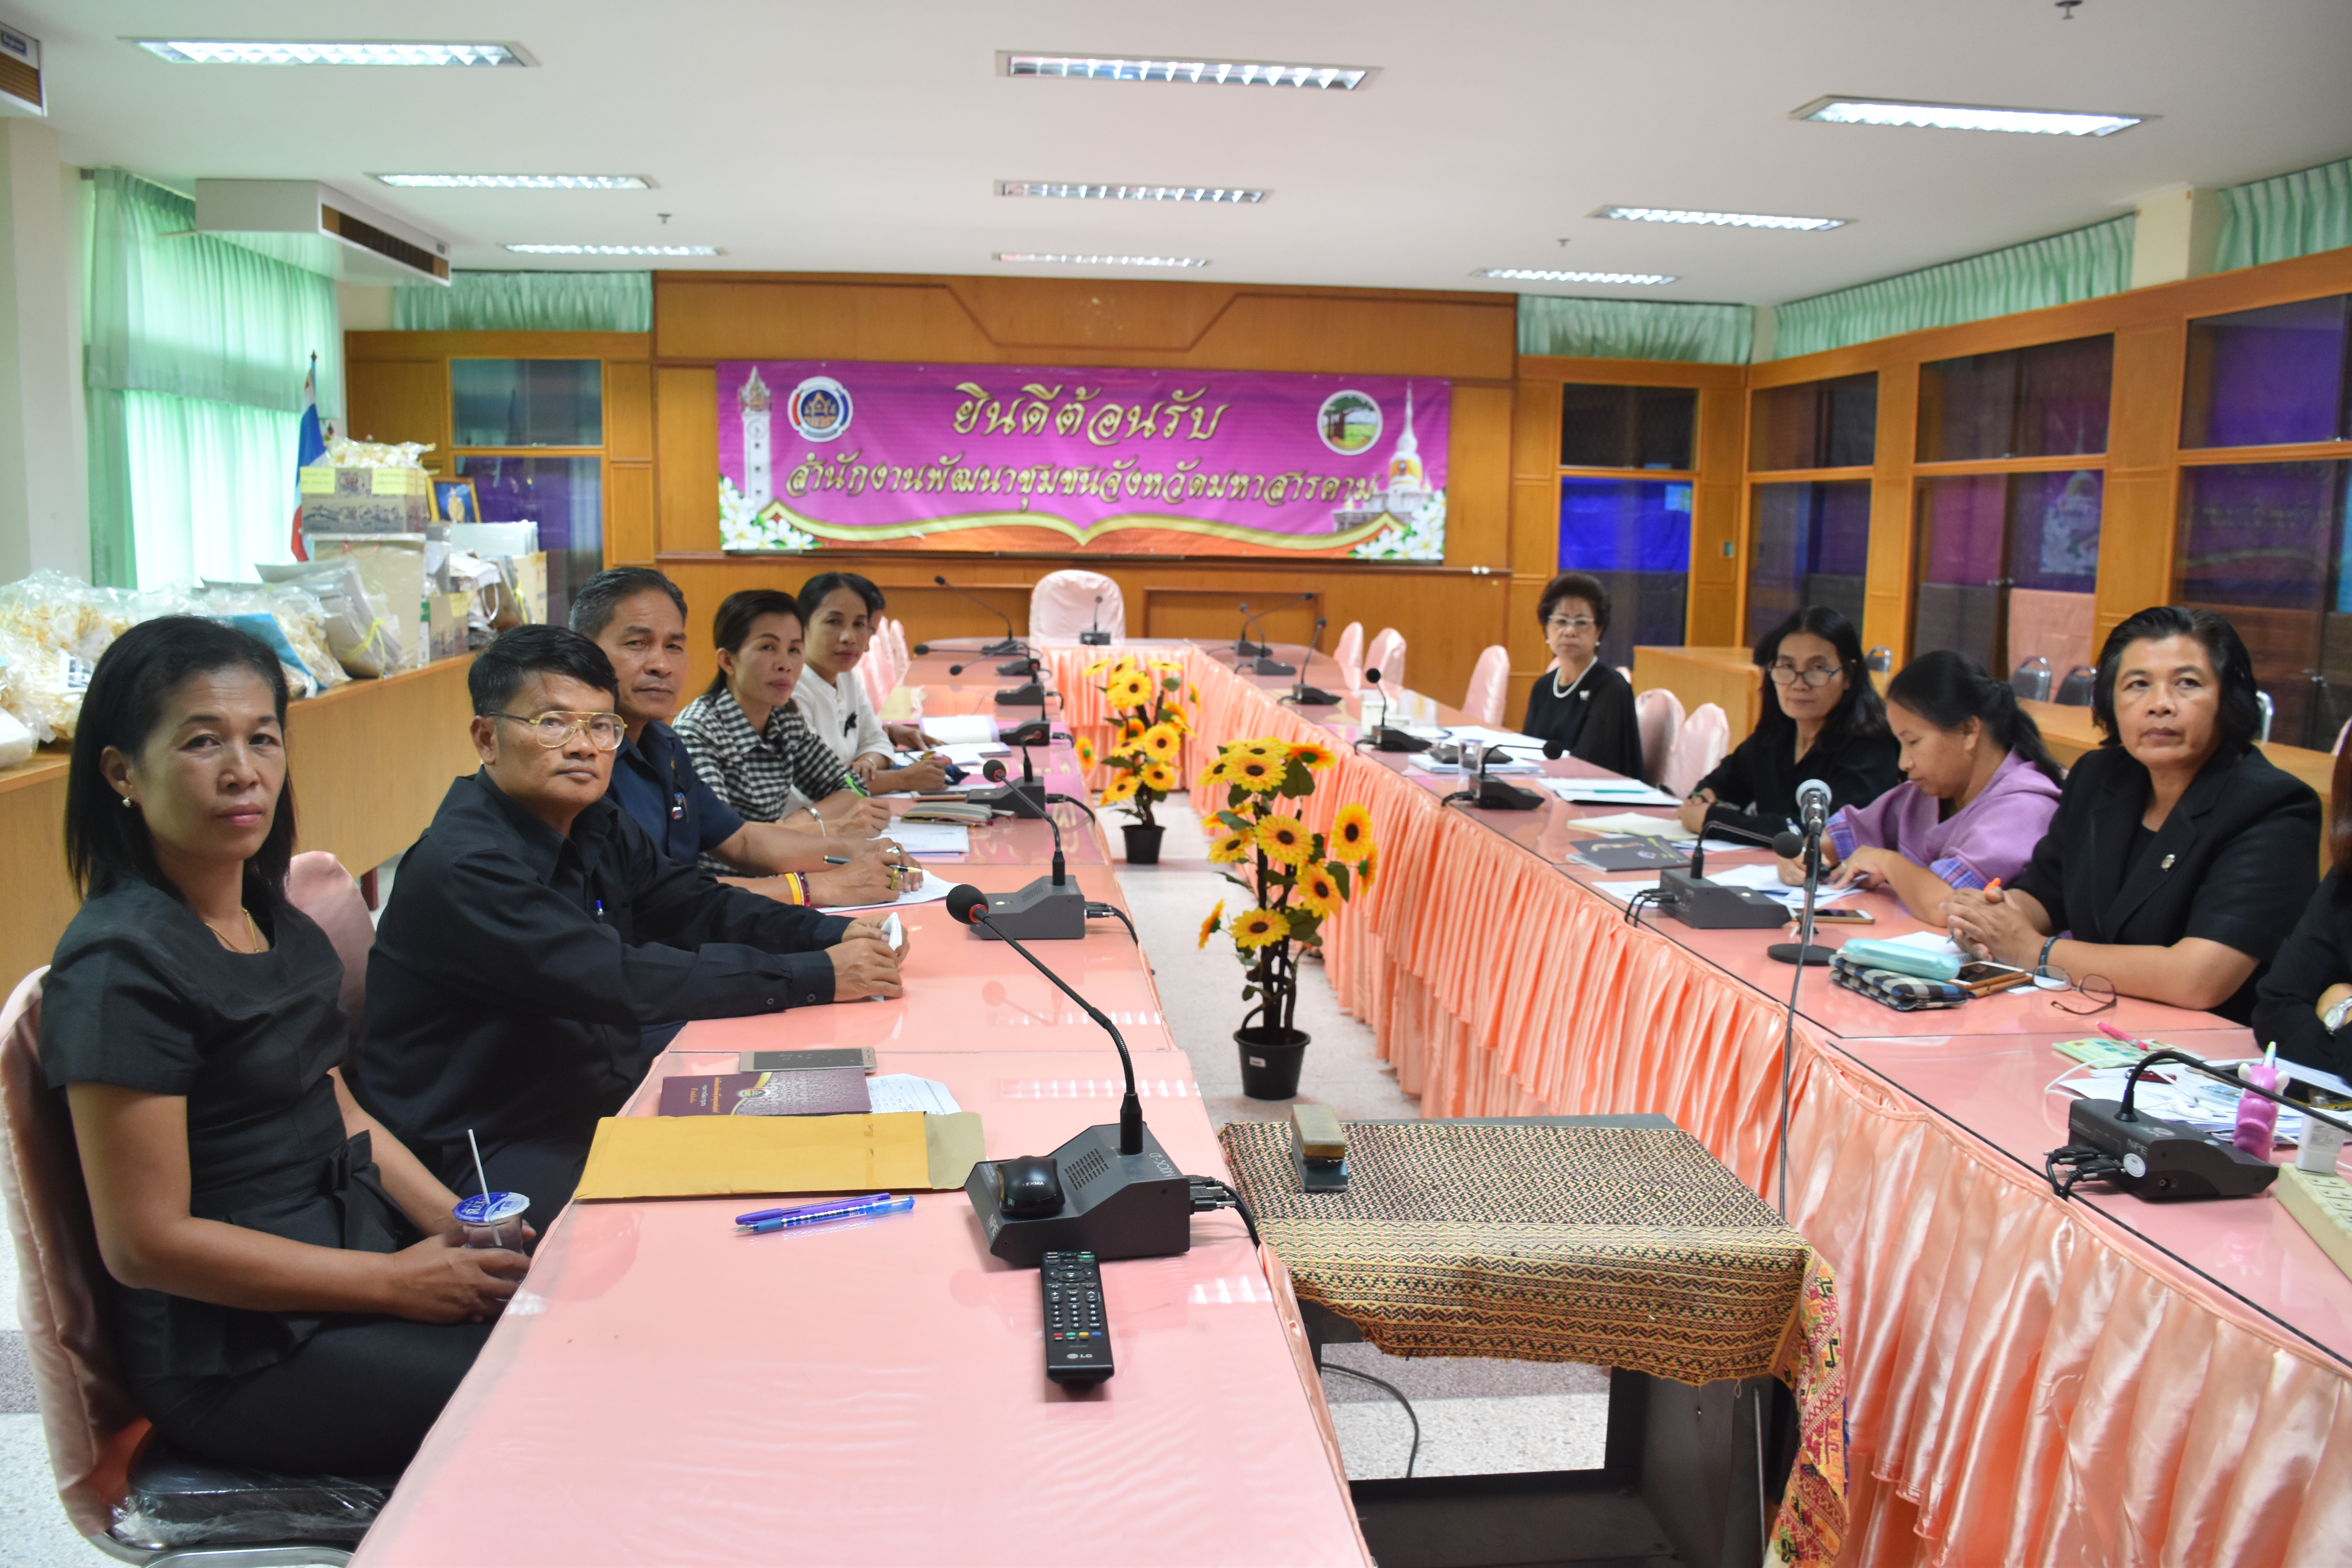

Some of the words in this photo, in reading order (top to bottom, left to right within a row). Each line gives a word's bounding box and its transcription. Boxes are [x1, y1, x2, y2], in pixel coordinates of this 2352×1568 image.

[953, 381, 1230, 446] ยินดีต้อนรับ
[786, 448, 1383, 511] สำนักงานพัฒนาชุมชนจังหวัดมหาสารคาม
